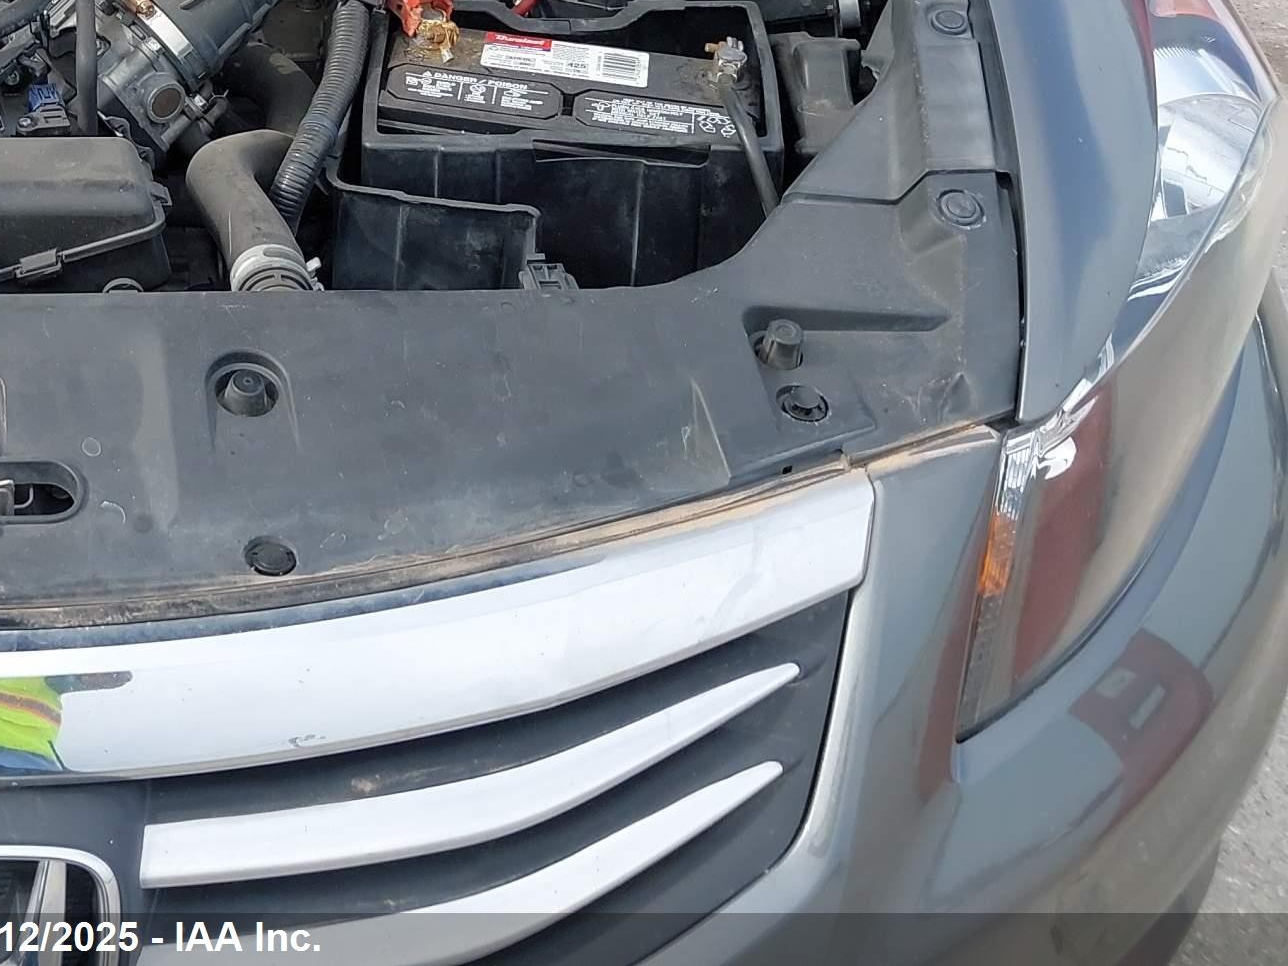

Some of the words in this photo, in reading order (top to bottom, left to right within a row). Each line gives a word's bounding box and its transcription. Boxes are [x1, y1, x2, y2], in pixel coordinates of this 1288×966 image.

[495, 34, 546, 46] Duralast
[433, 72, 478, 84] DANGER
[487, 79, 528, 90] POISON
